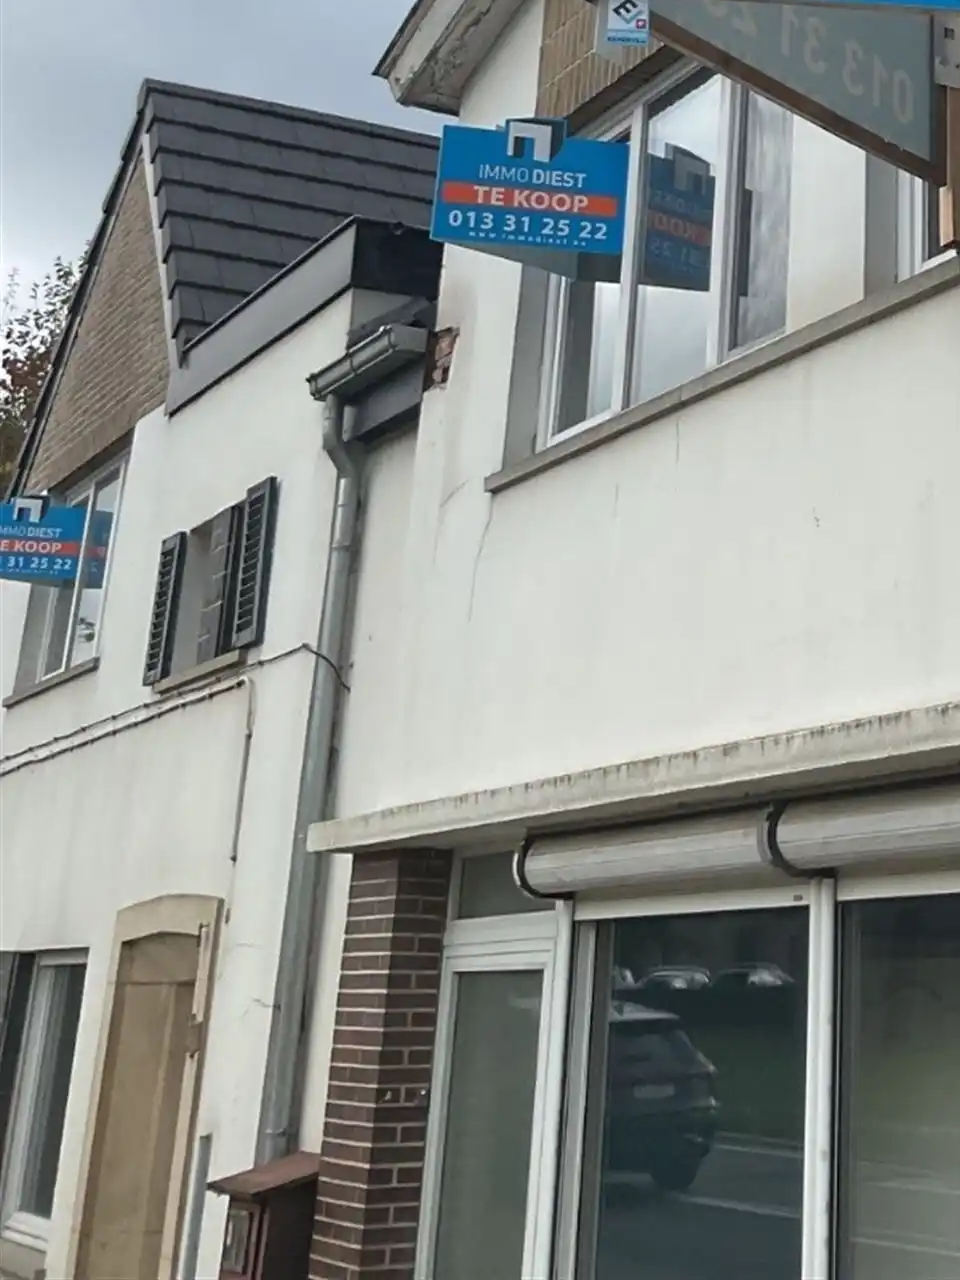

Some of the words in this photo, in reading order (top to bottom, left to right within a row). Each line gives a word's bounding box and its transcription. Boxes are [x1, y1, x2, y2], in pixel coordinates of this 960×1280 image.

[479, 164, 529, 184] IMMO
[532, 169, 587, 188] DIEST
[473, 185, 505, 206] TE
[513, 190, 588, 213] KOOP
[448, 210, 494, 230] 013
[503, 214, 530, 233] 31
[541, 218, 570, 237] 25
[579, 221, 608, 240] 22
[0, 525, 26, 537] MMO
[0, 539, 9, 552] E
[14, 540, 62, 553] KOOP
[8, 556, 24, 568] 31
[30, 557, 49, 569] 25
[53, 558, 73, 570] 22
